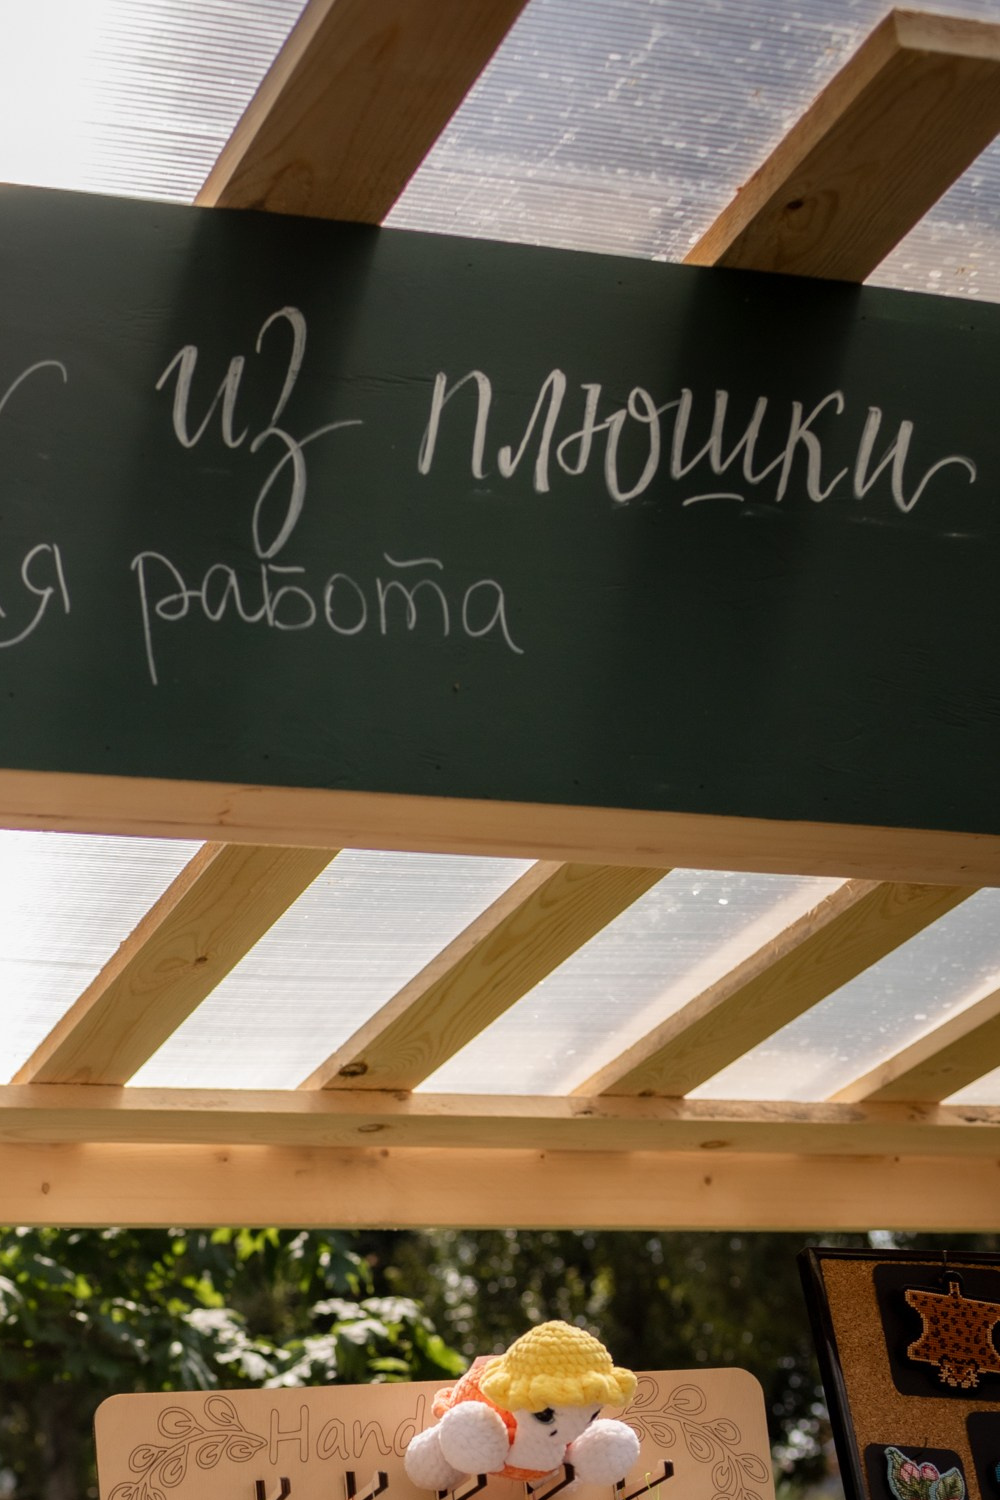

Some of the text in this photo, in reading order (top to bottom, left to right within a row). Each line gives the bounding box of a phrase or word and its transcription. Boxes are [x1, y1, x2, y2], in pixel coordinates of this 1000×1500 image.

[156, 306, 363, 558] из
[418, 368, 977, 513] плюшки
[131, 550, 525, 686] работа
